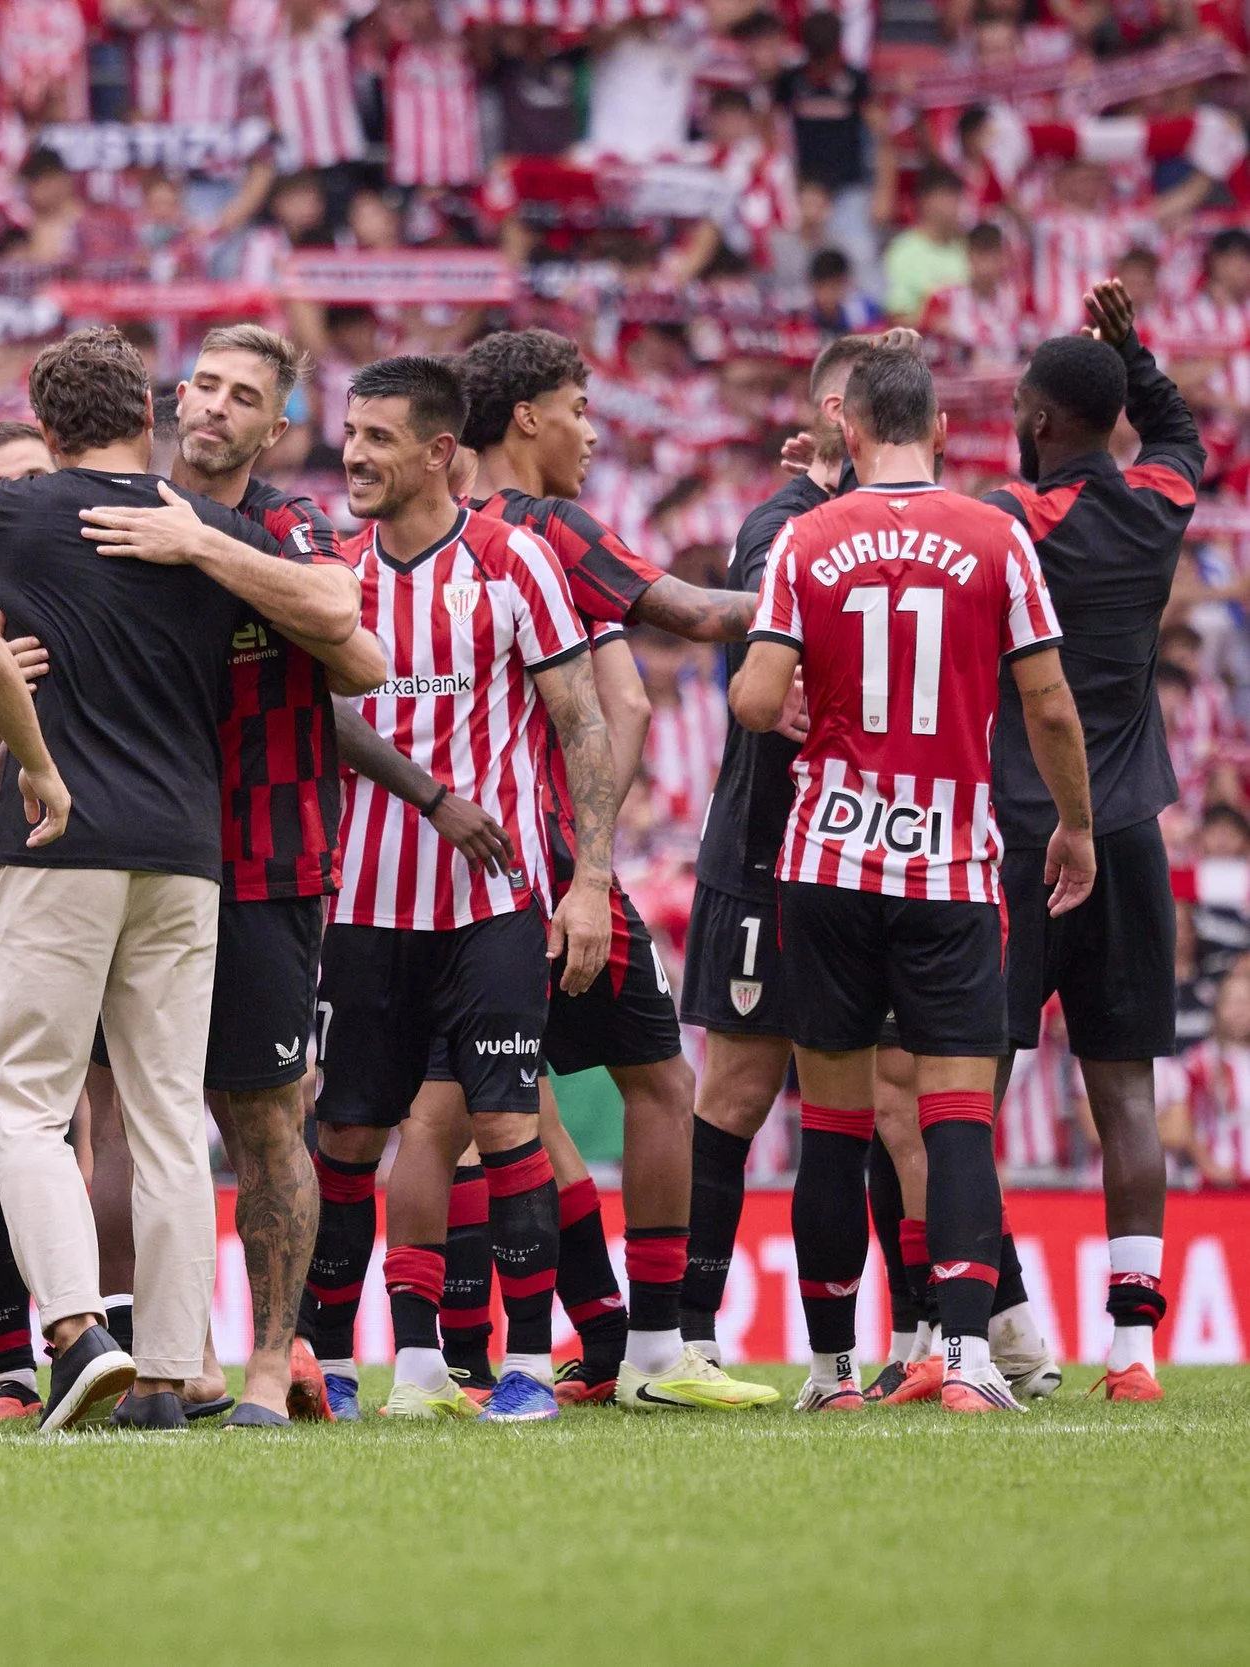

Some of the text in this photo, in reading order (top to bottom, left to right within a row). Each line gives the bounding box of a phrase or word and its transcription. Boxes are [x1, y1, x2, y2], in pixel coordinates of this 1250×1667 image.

[810, 529, 978, 587] GURUZETA
[233, 649, 279, 664] eficiente
[842, 586, 944, 735] 11
[818, 791, 942, 856] DIGI
[741, 916, 761, 977] 1
[836, 1353, 853, 1382] NEO
[948, 1336, 961, 1370] NEO
